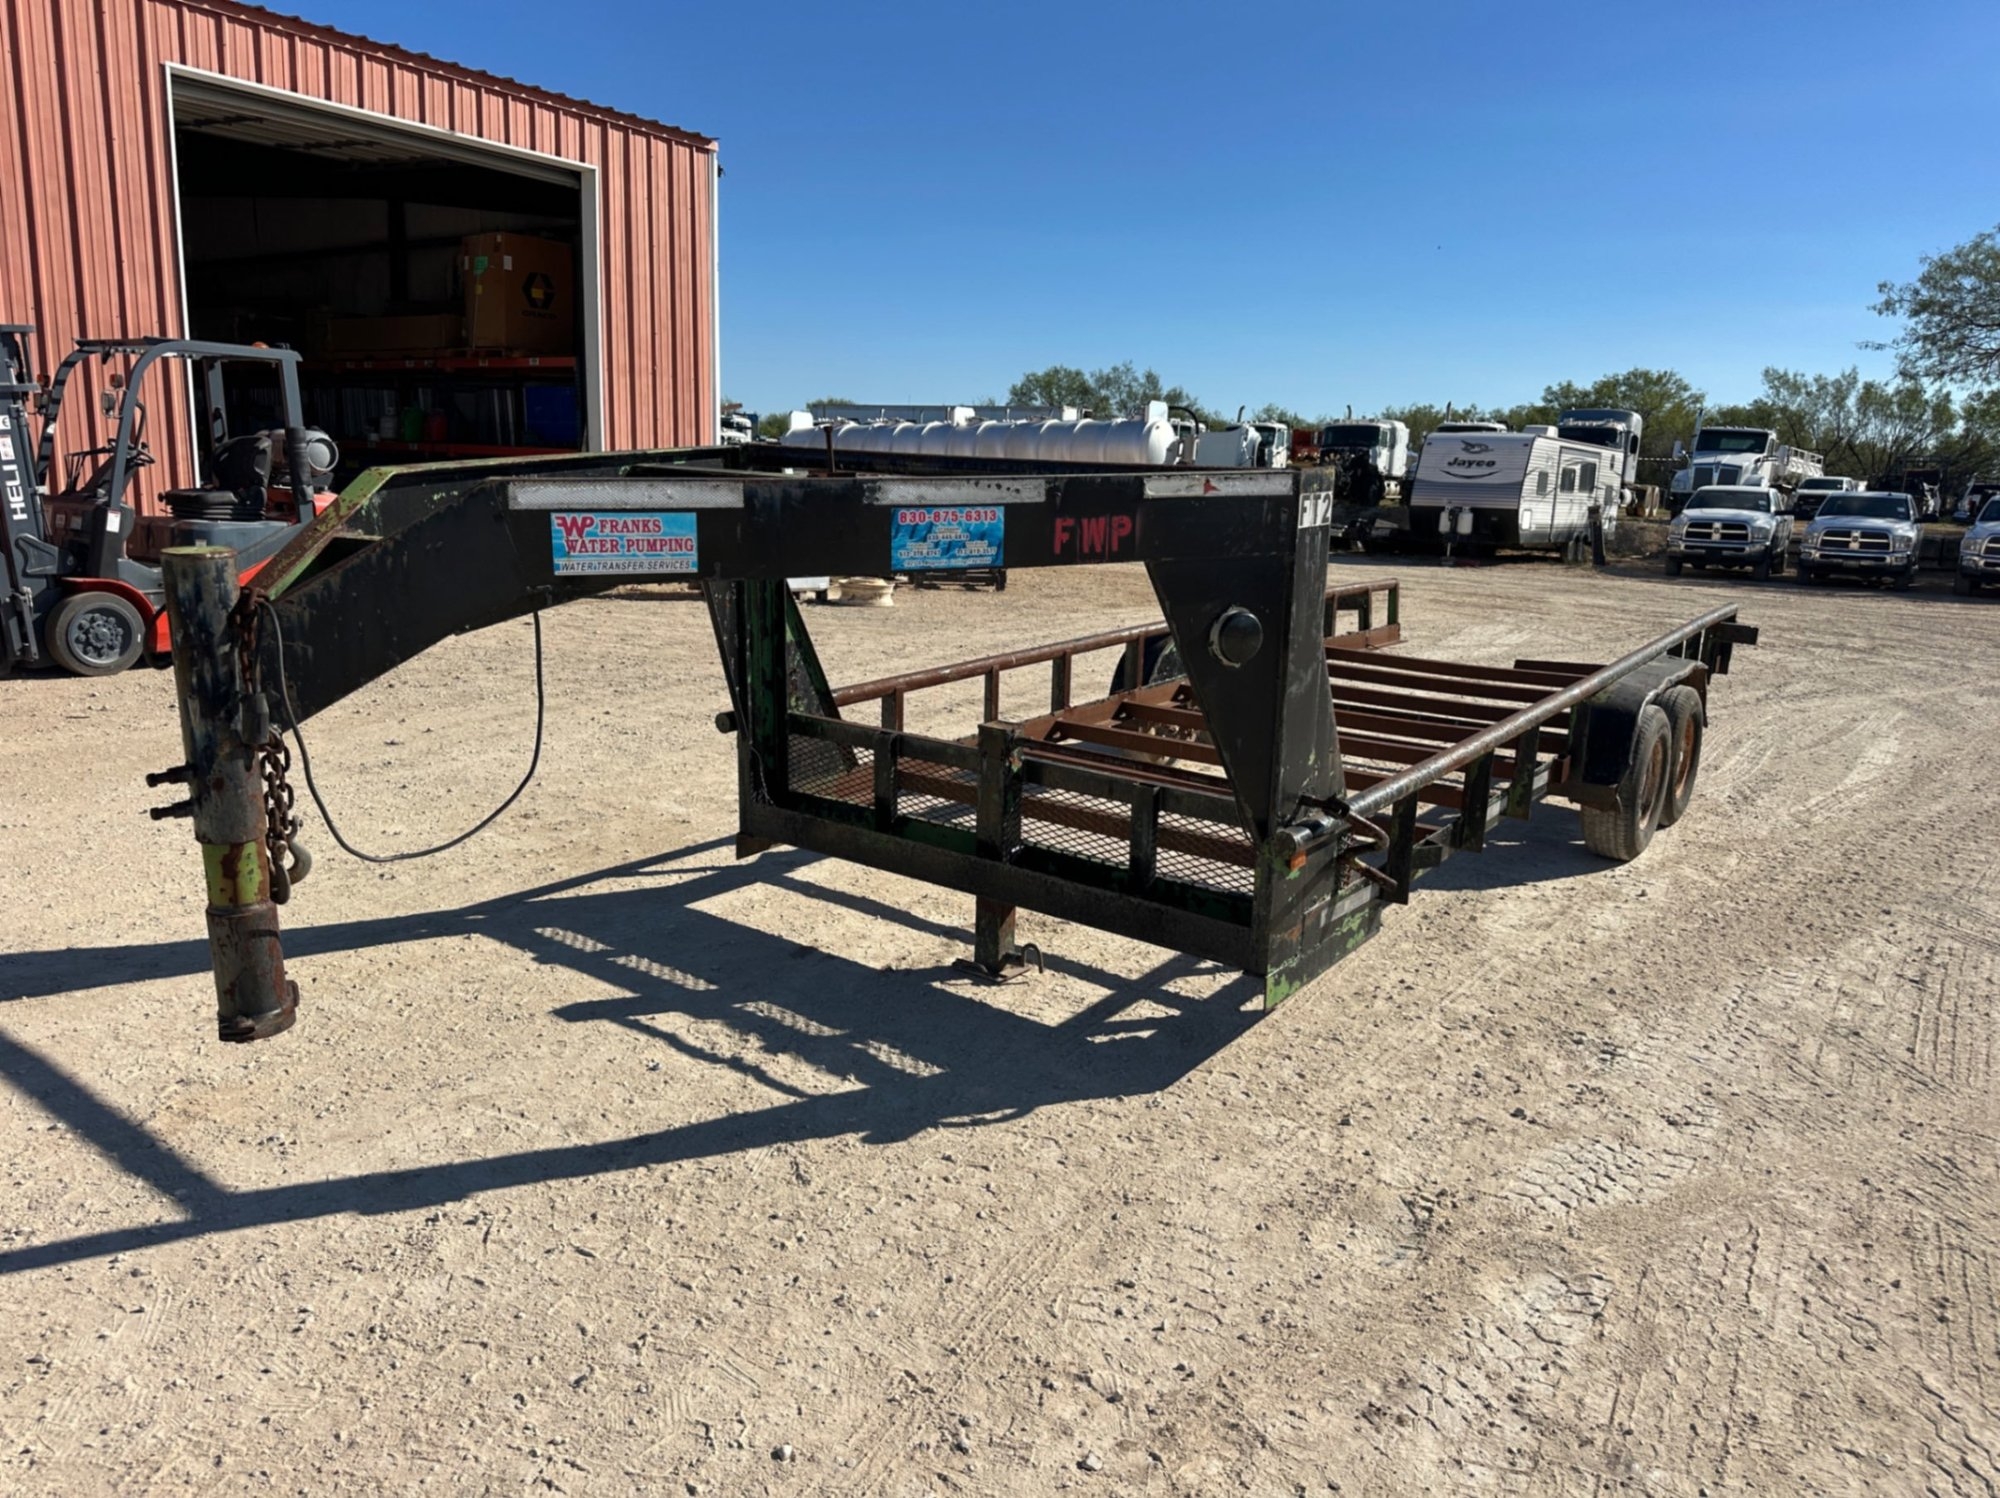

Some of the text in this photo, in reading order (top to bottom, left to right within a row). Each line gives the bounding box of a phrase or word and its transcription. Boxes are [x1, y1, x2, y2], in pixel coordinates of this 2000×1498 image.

[1447, 457, 1496, 469] Jayco
[2, 463, 28, 520] HELI
[899, 509, 997, 523] 830-875-6313
[599, 519, 661, 533] FRANKS
[565, 538, 694, 553] WATER PUMPING
[561, 560, 690, 571] WATER TRANSFER SERVICES
